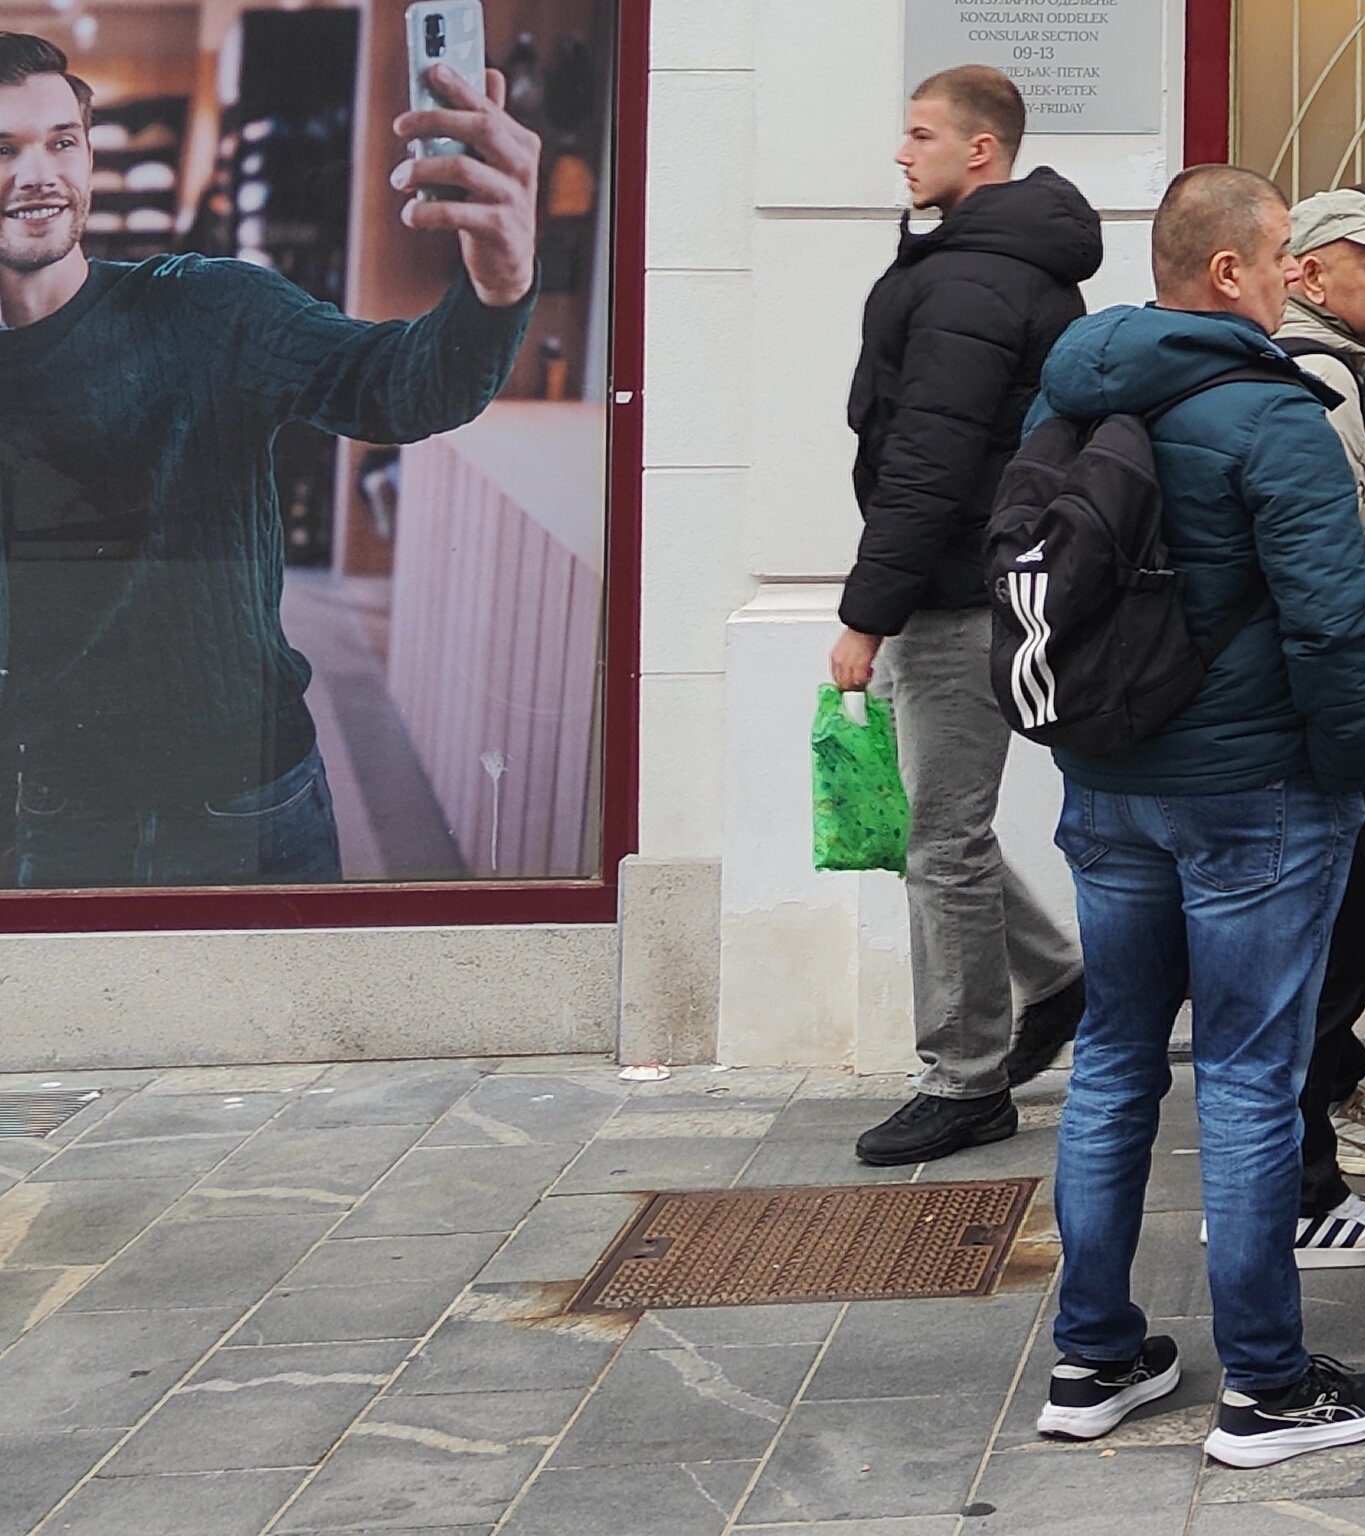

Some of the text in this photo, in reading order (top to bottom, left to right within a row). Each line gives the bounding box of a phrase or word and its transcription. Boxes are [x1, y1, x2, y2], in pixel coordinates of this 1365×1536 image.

[960, 11, 1109, 24] KONZULARNI ODDELEK
[968, 30, 1099, 42] CONSULAR SECTION
[1013, 46, 1055, 60] 09-13
[998, 66, 1100, 78] ДЕЉАК-ПЕТАК
[1019, 85, 1098, 96] LJEK-PETEK
[1025, 103, 1085, 114] Y-FRIDAY
